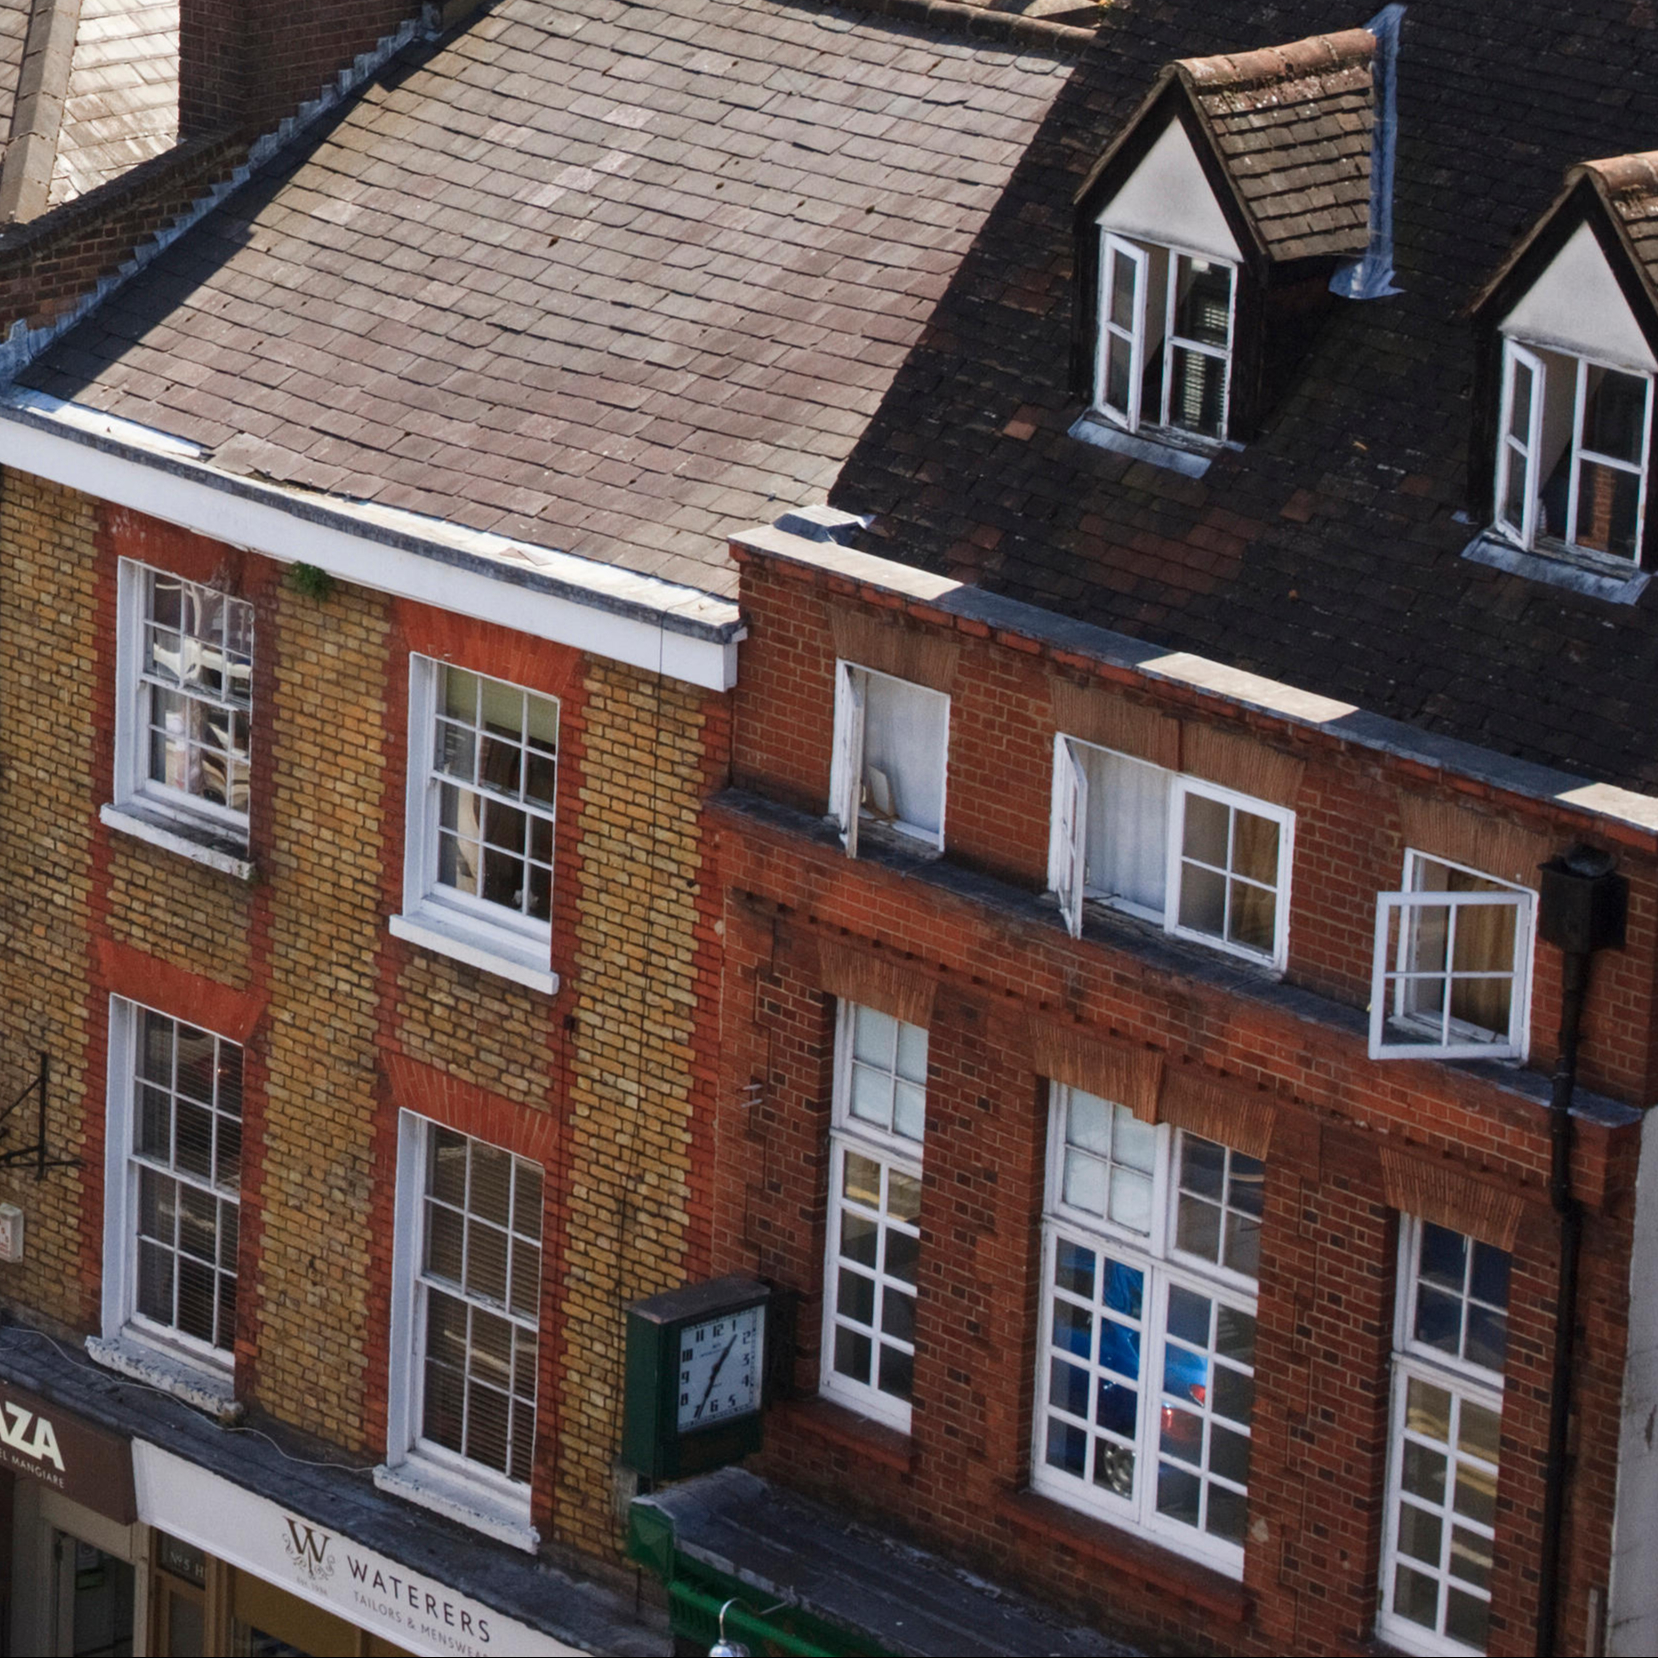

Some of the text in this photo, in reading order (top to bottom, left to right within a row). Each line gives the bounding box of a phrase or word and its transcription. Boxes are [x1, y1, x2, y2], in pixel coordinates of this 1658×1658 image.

[696, 1329, 704, 1343] 11
[713, 1323, 724, 1338] 12
[742, 1331, 751, 1345] 2
[742, 1353, 750, 1367] 3
[681, 1371, 690, 1385] 9
[741, 1374, 749, 1387] 4
[680, 1392, 689, 1407] 8
[710, 1399, 719, 1413] 6
[728, 1393, 736, 1407] 5
[11, 1455, 65, 1489] MANGIARE
[347, 1554, 491, 1643] WATERERS
[353, 1591, 403, 1624] TAILORS
[406, 1617, 416, 1630] &
